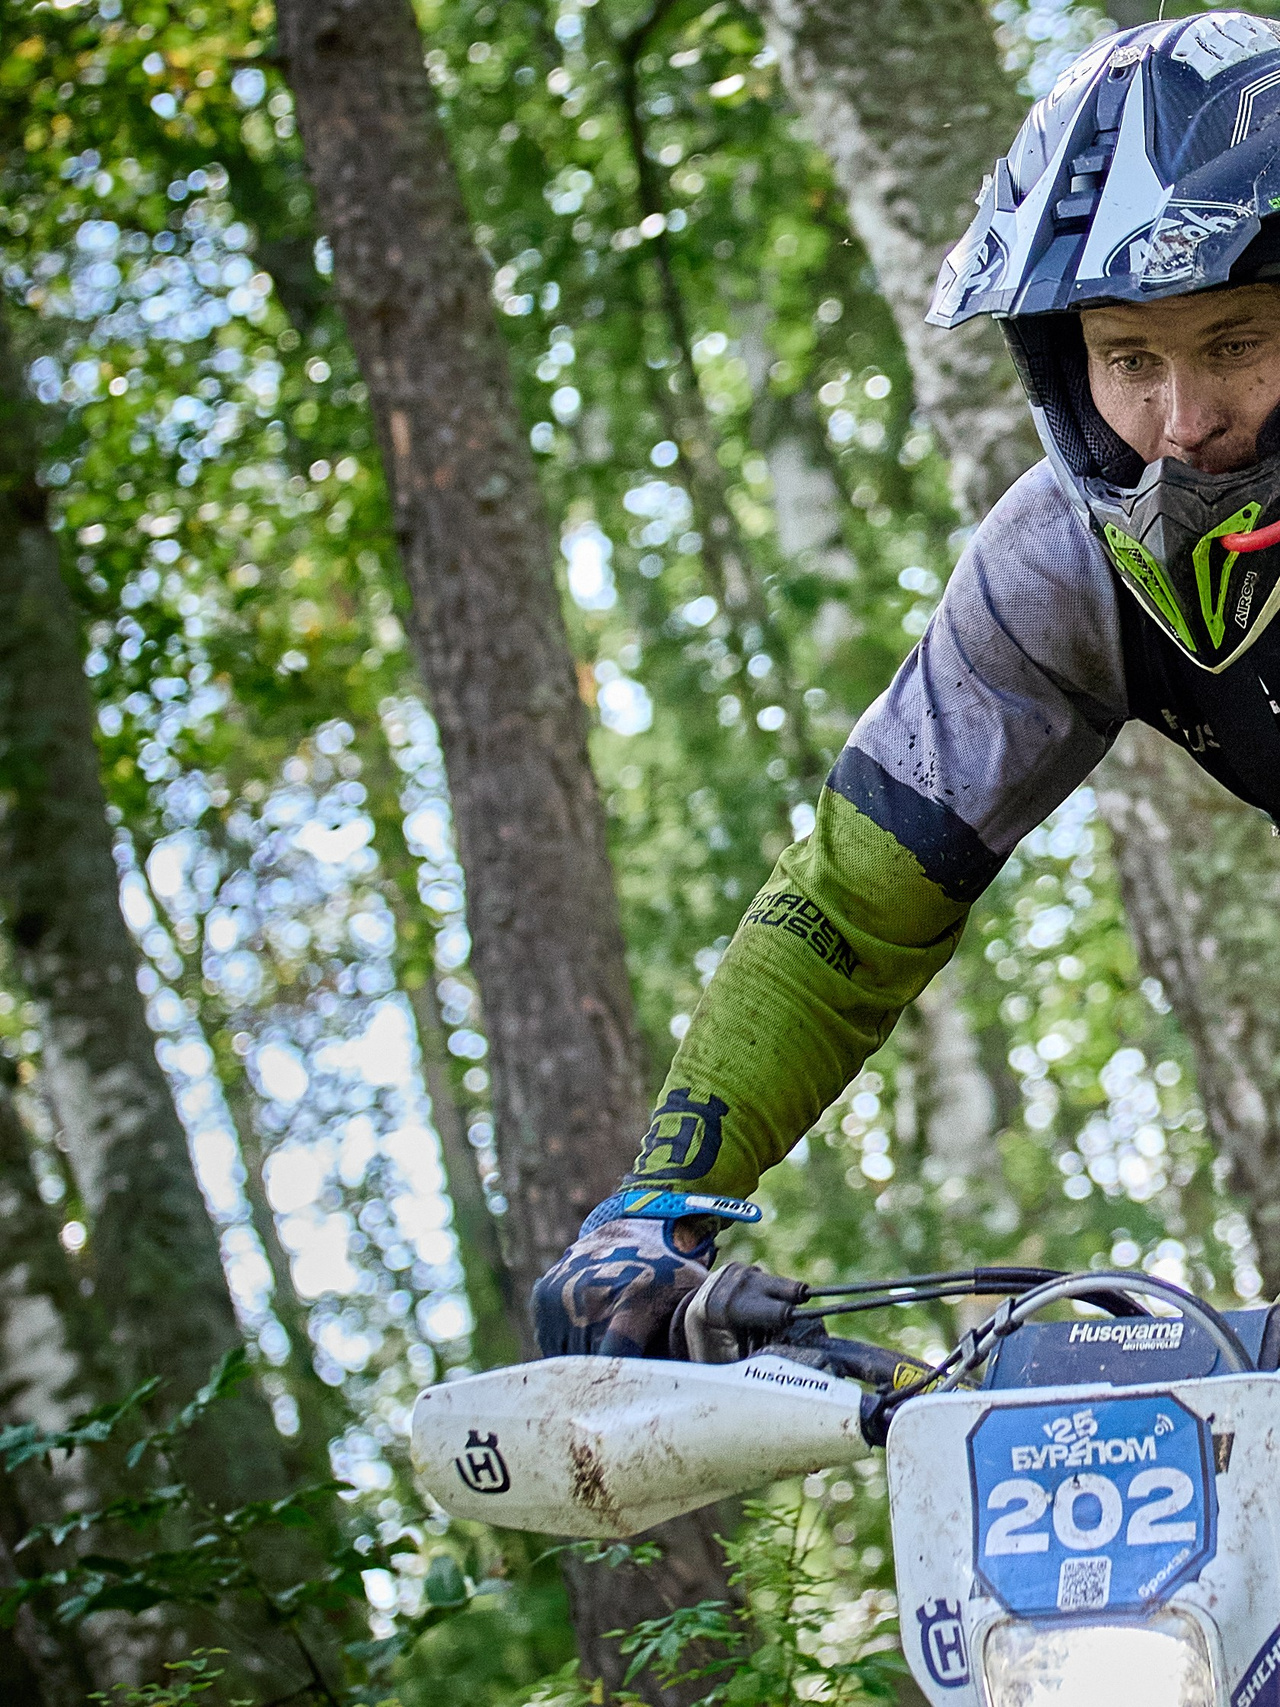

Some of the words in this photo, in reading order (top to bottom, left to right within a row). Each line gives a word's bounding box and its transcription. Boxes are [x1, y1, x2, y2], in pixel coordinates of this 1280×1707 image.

[1071, 1321, 1184, 1344] Husqvarna
[744, 1365, 829, 1392] Husqvarna
[984, 1466, 1197, 1557] 202
